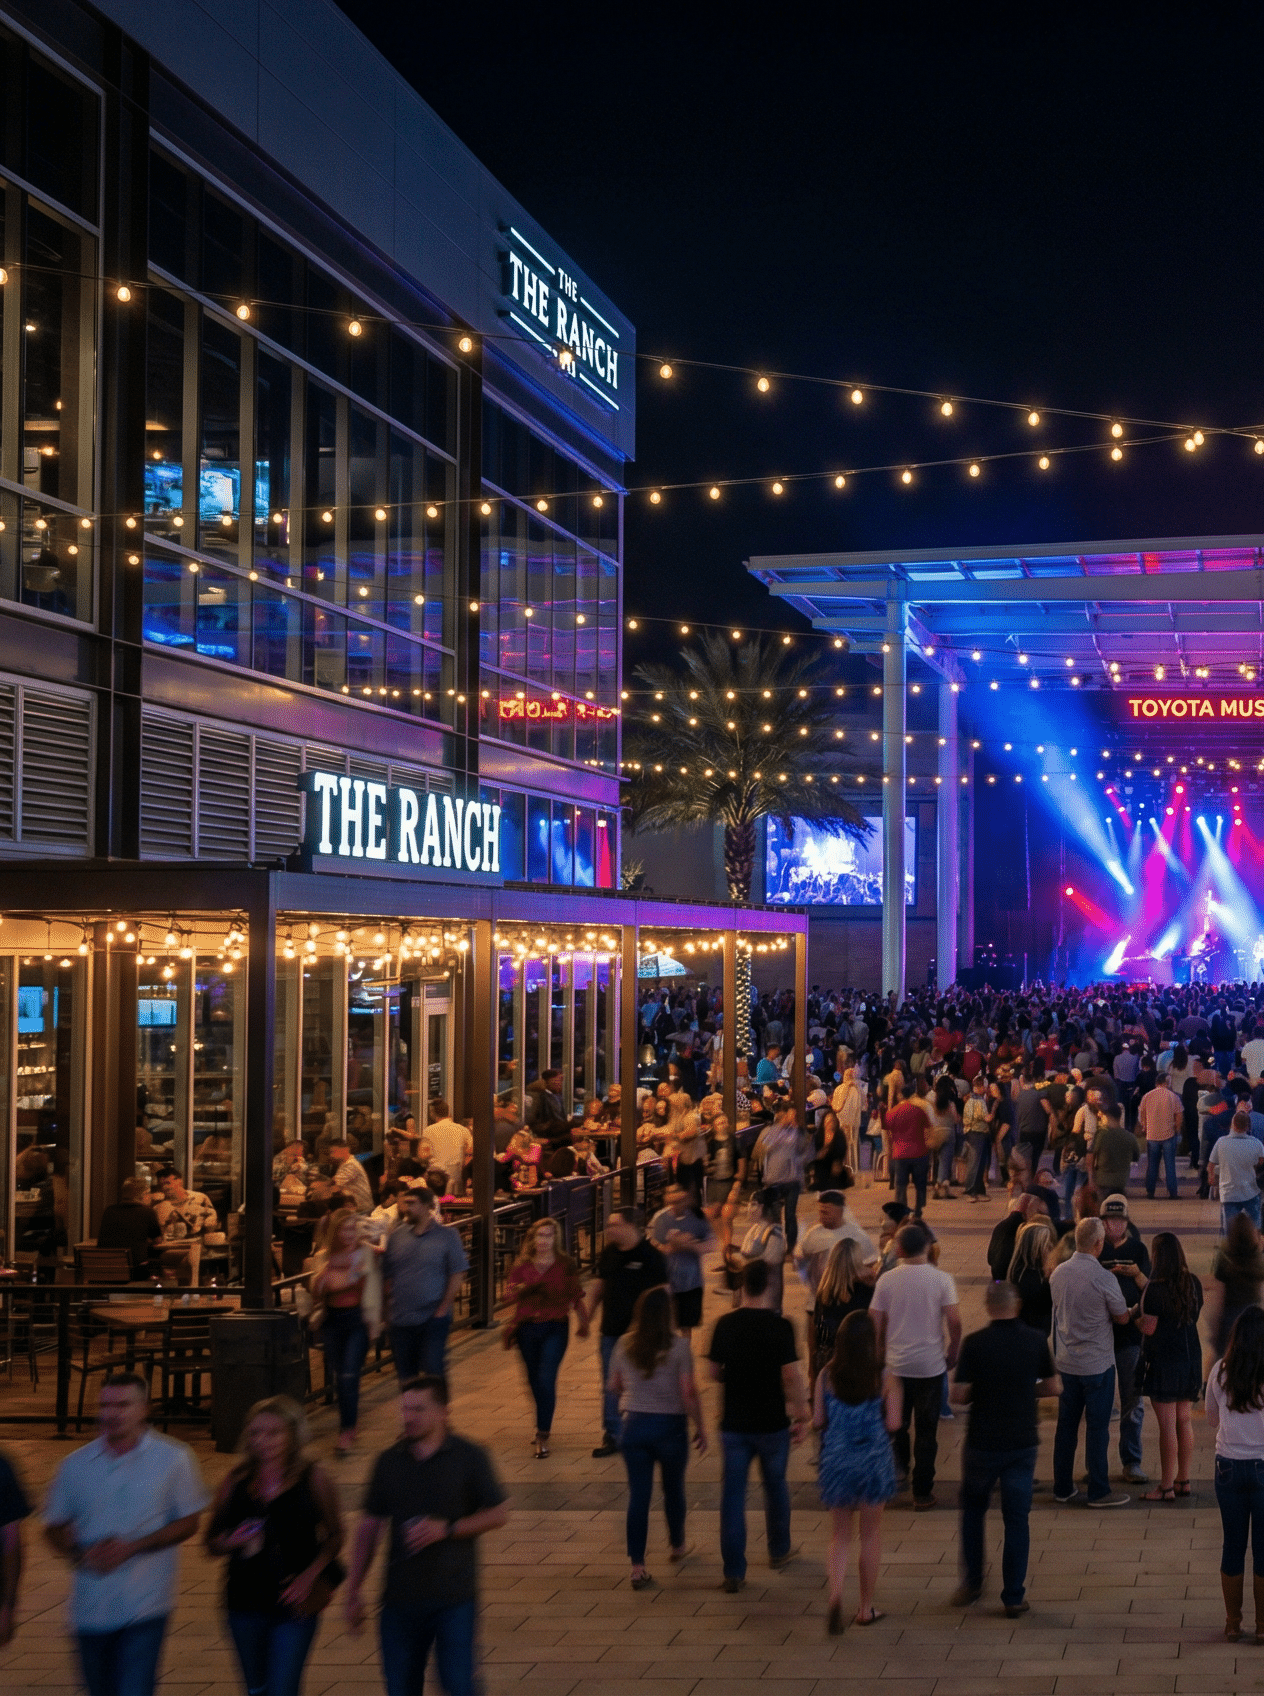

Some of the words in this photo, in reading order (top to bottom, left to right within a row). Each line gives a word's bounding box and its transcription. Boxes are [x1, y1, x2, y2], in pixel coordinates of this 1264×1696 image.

[557, 267, 578, 303] THE
[509, 250, 550, 328] THE
[556, 297, 619, 390] RANCH
[1129, 699, 1214, 717] TOYOTA
[314, 771, 387, 860] THE
[397, 788, 502, 873] RANCH
